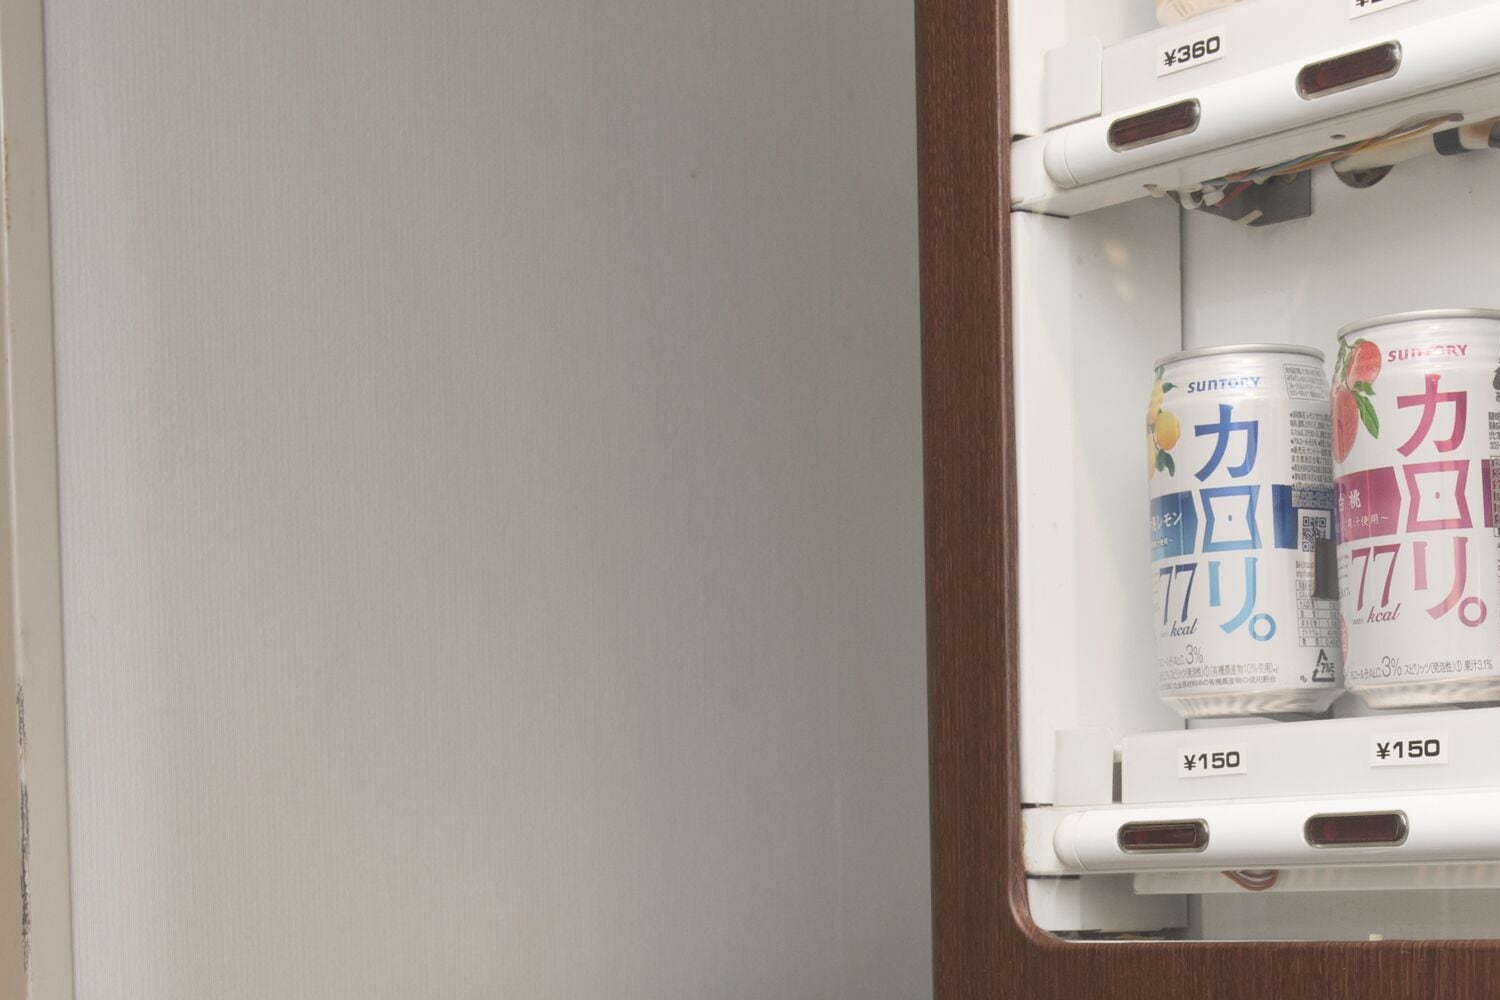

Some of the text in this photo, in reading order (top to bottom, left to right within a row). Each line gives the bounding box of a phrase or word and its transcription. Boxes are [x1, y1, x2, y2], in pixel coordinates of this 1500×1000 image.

[1163, 35, 1221, 67] ¥360
[1387, 344, 1468, 362] SUNRY
[1352, 543, 1402, 611] 77
[1159, 563, 1198, 625] 77
[1367, 603, 1402, 624] kcal
[1170, 618, 1198, 637] kcal
[1182, 750, 1242, 772] ¥150
[1376, 739, 1442, 761] ¥150
